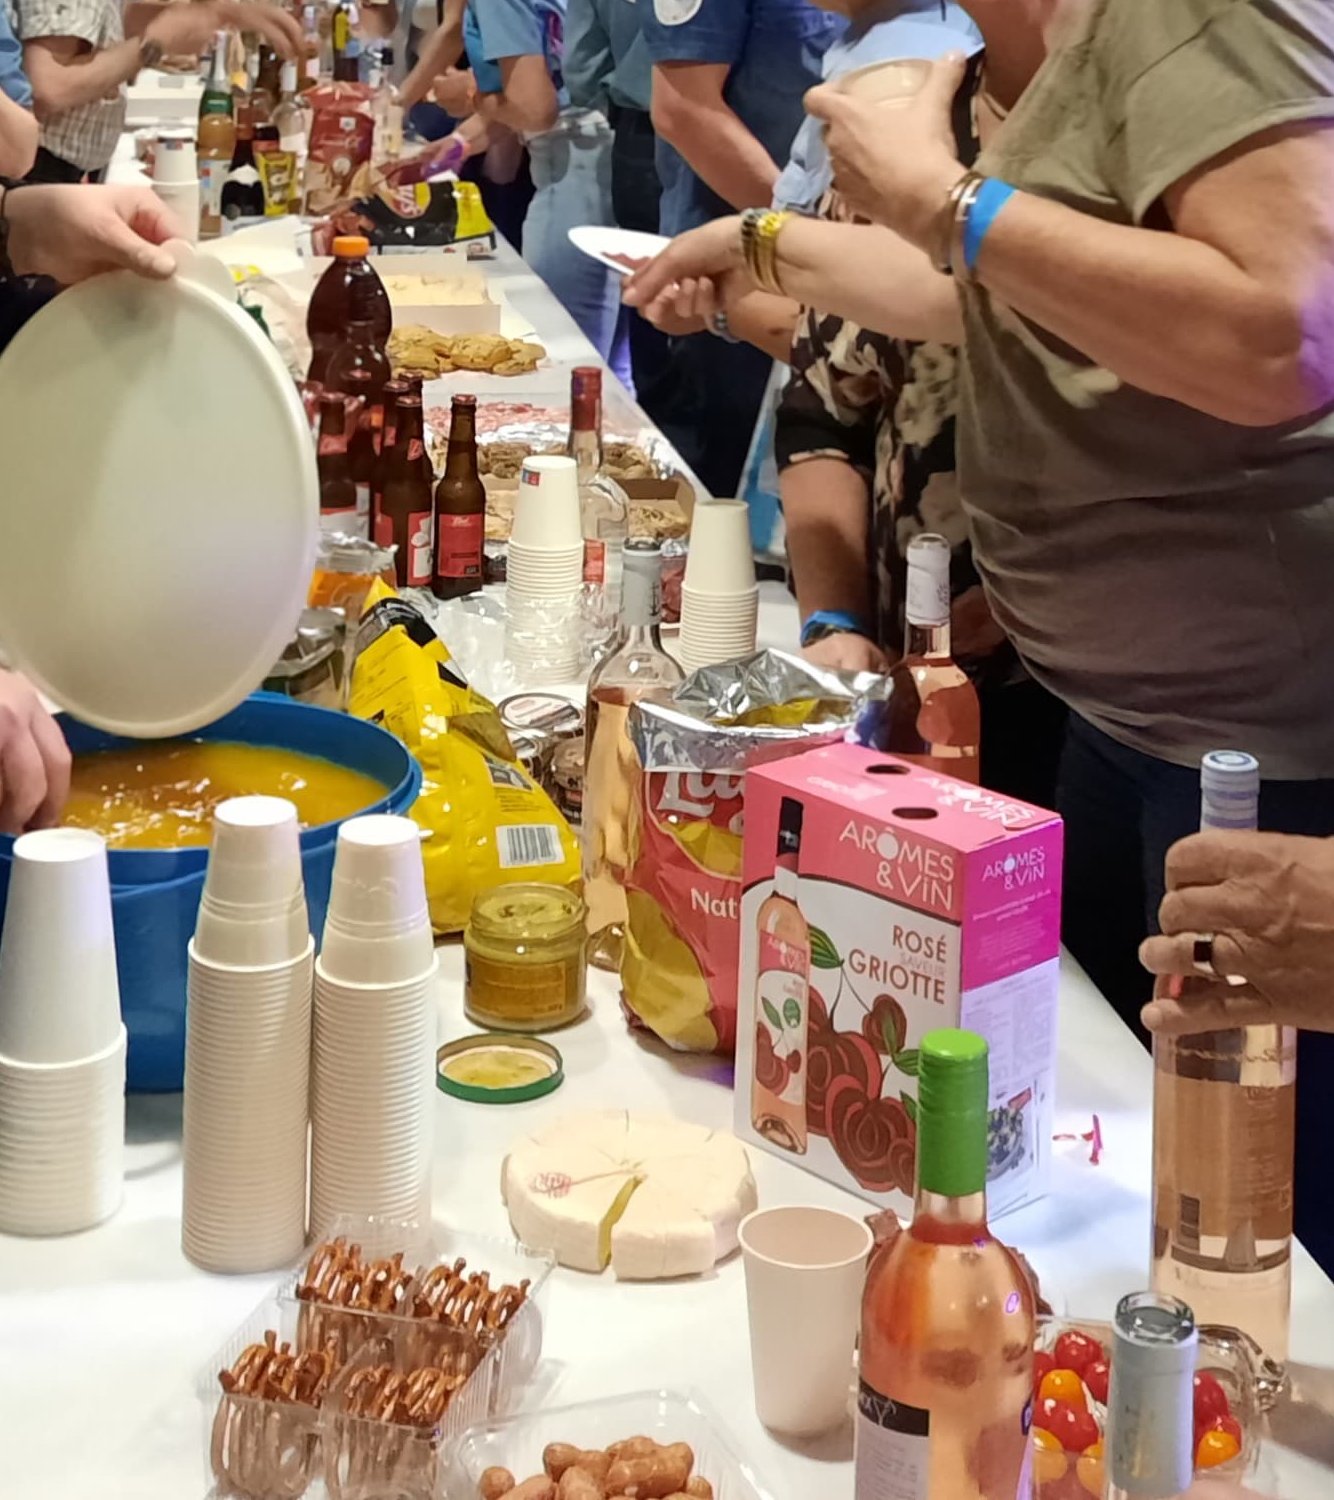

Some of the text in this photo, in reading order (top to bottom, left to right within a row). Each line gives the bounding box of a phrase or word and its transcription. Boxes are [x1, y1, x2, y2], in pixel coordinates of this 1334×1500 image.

[839, 820, 955, 884] ARÔMES
[892, 924, 947, 964] ROSÉ
[848, 947, 946, 1006] GRIOTTE
